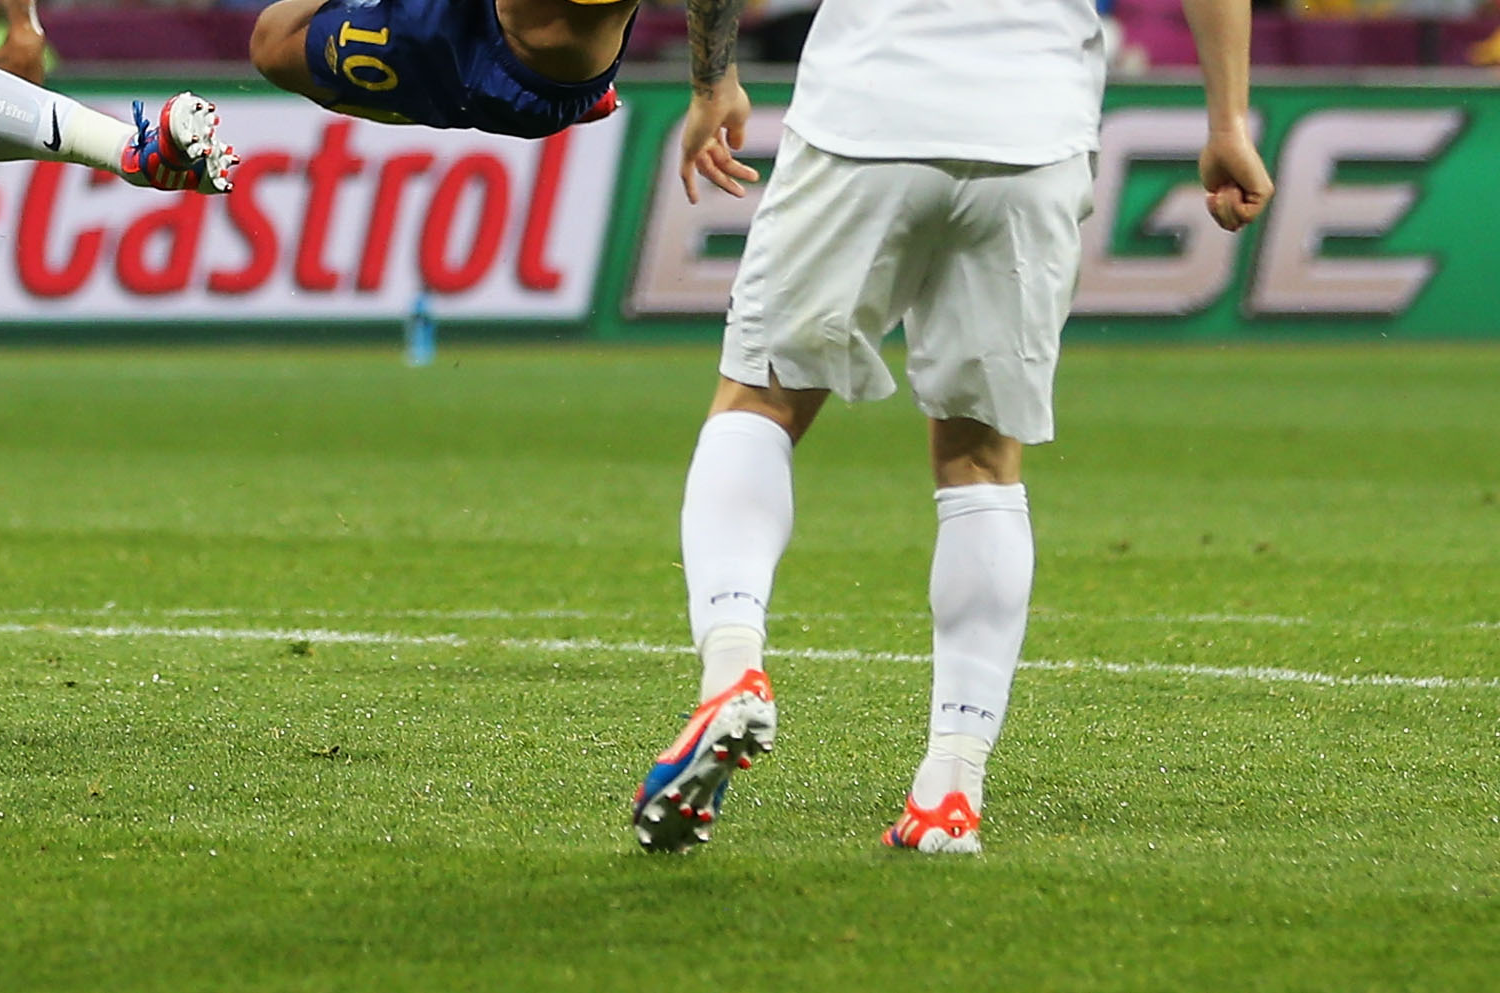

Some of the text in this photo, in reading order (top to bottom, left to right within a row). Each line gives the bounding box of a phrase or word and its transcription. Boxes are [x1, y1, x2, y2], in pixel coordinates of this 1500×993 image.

[339, 20, 399, 92] 10
[15, 117, 571, 298] Castrol
[622, 107, 1465, 319] EGE
[942, 703, 997, 722] FFF
